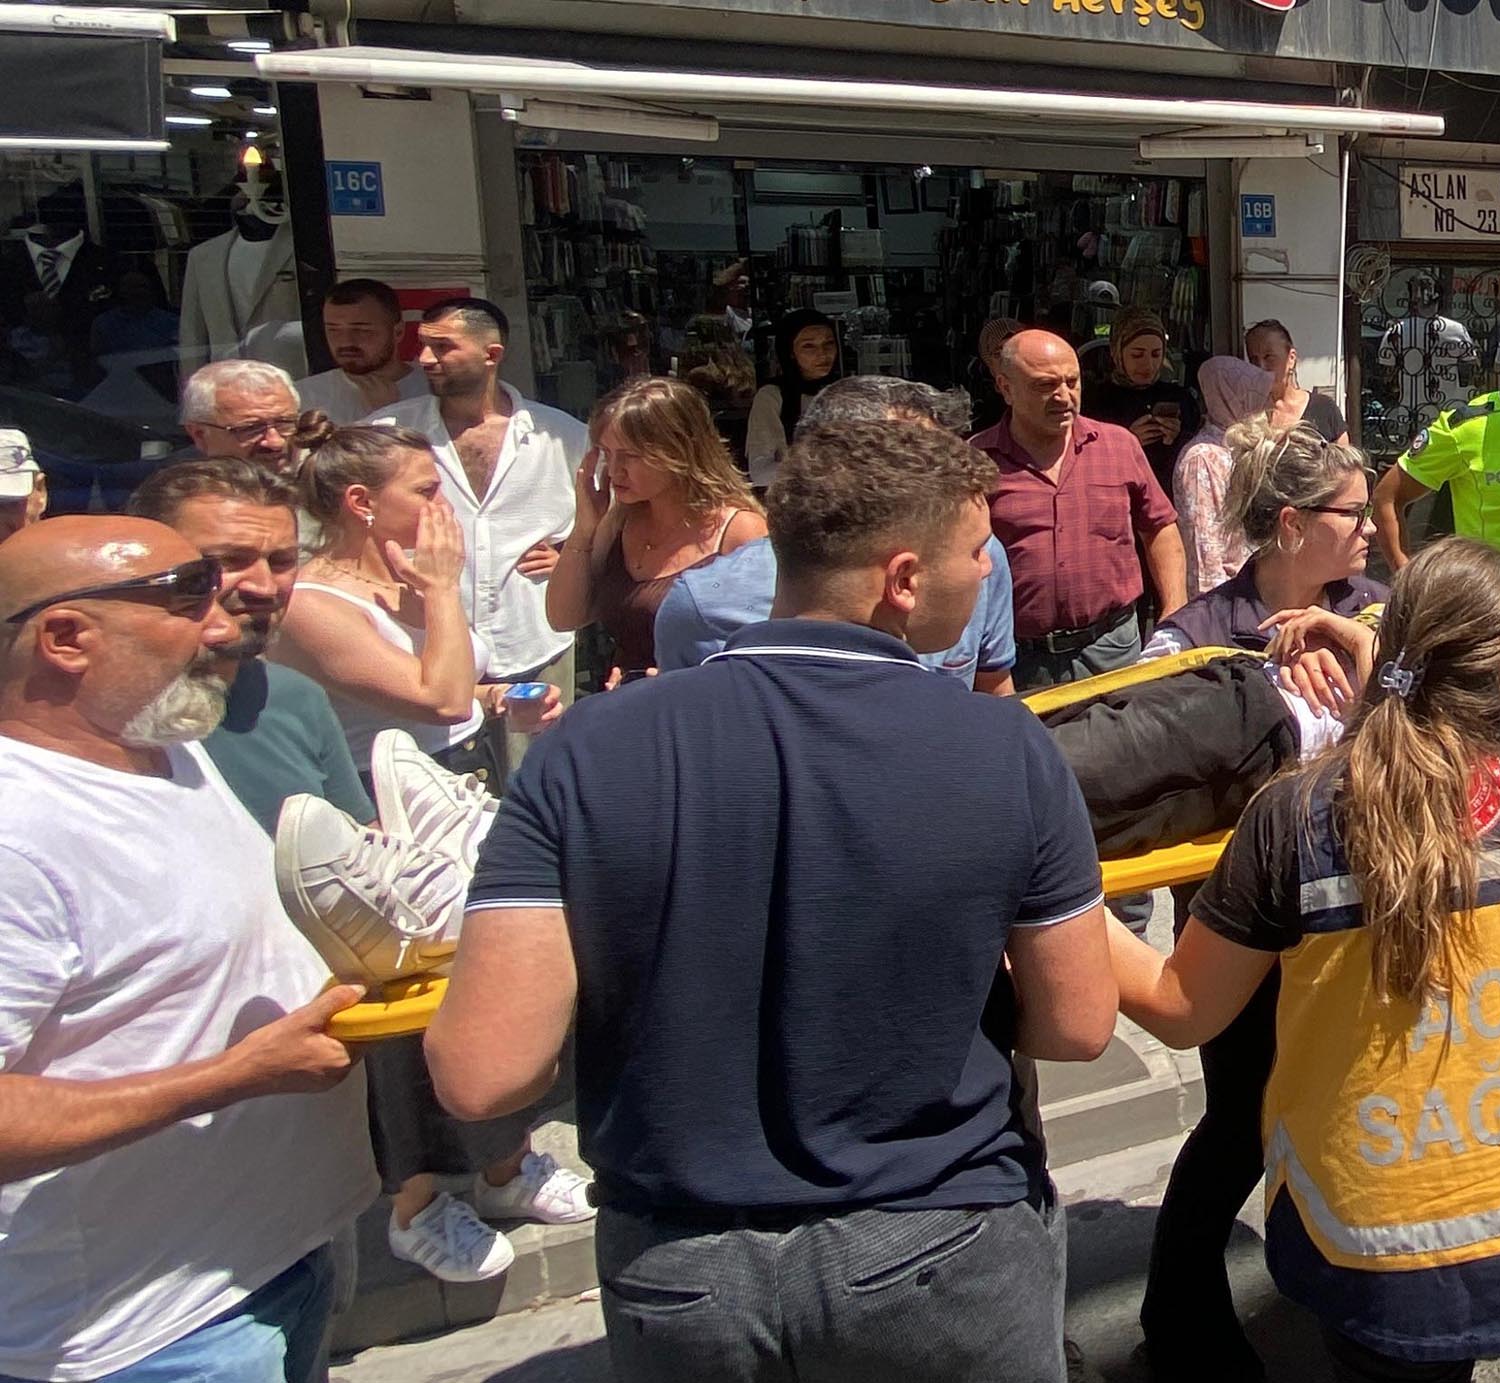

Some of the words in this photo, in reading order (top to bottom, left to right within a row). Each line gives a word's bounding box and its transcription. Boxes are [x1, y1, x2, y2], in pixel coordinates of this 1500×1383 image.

[333, 170, 377, 192] 16C
[1410, 173, 1466, 200] ASLAN
[1245, 202, 1272, 218] 16B
[1434, 208, 1454, 232] NO
[1477, 209, 1497, 233] 23
